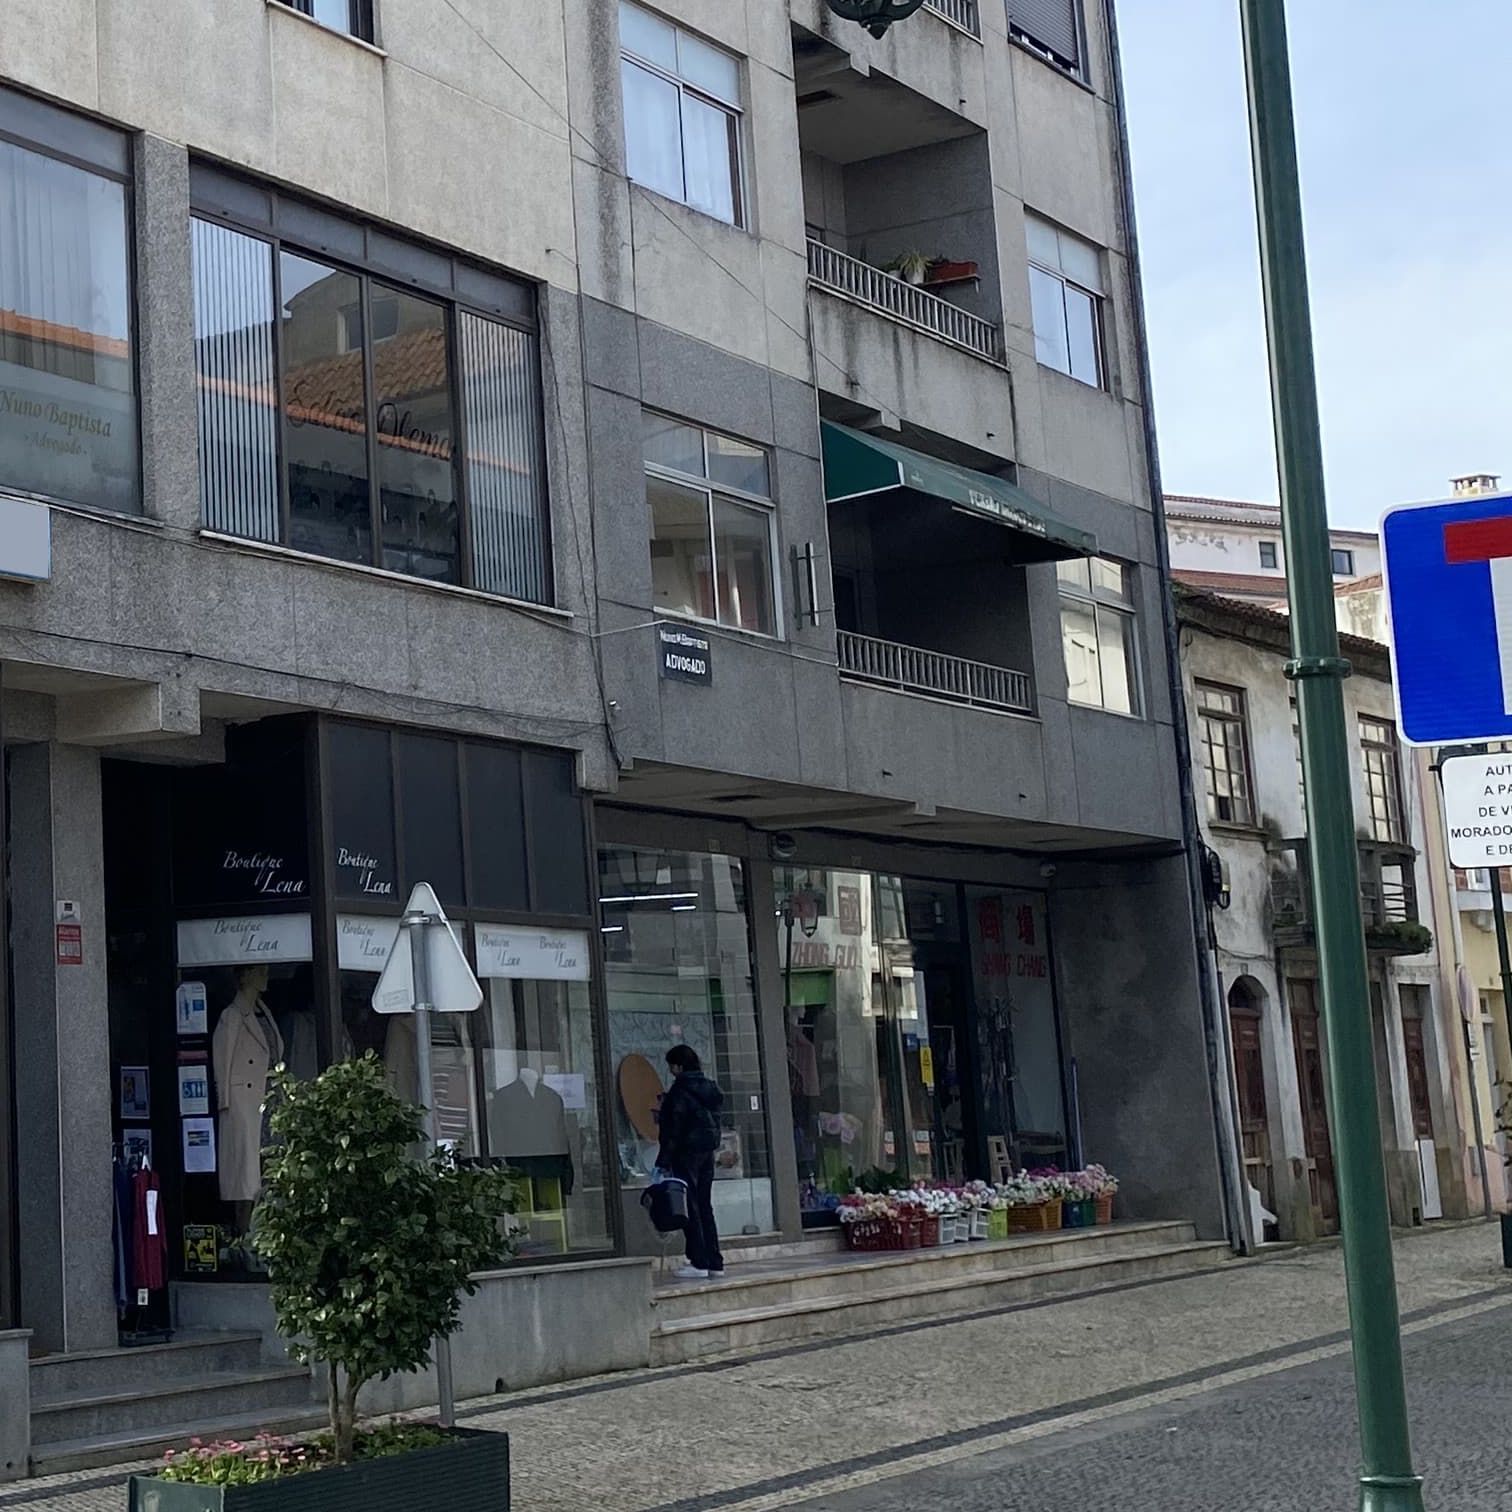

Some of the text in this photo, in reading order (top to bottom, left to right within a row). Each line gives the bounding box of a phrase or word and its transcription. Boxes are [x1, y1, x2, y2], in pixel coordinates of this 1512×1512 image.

[46, 401, 112, 437] Baptista
[666, 653, 706, 675] ADVOGADO
[1484, 785, 1494, 796] A
[1478, 805, 1512, 818] DE V
[1486, 845, 1495, 856] E
[223, 850, 283, 886] Boutique
[338, 847, 379, 884] Boutique
[260, 871, 304, 893] Lena
[363, 871, 392, 894] Lena
[214, 919, 262, 947] Boutique
[245, 934, 279, 952] Lena
[363, 938, 387, 957] Lena
